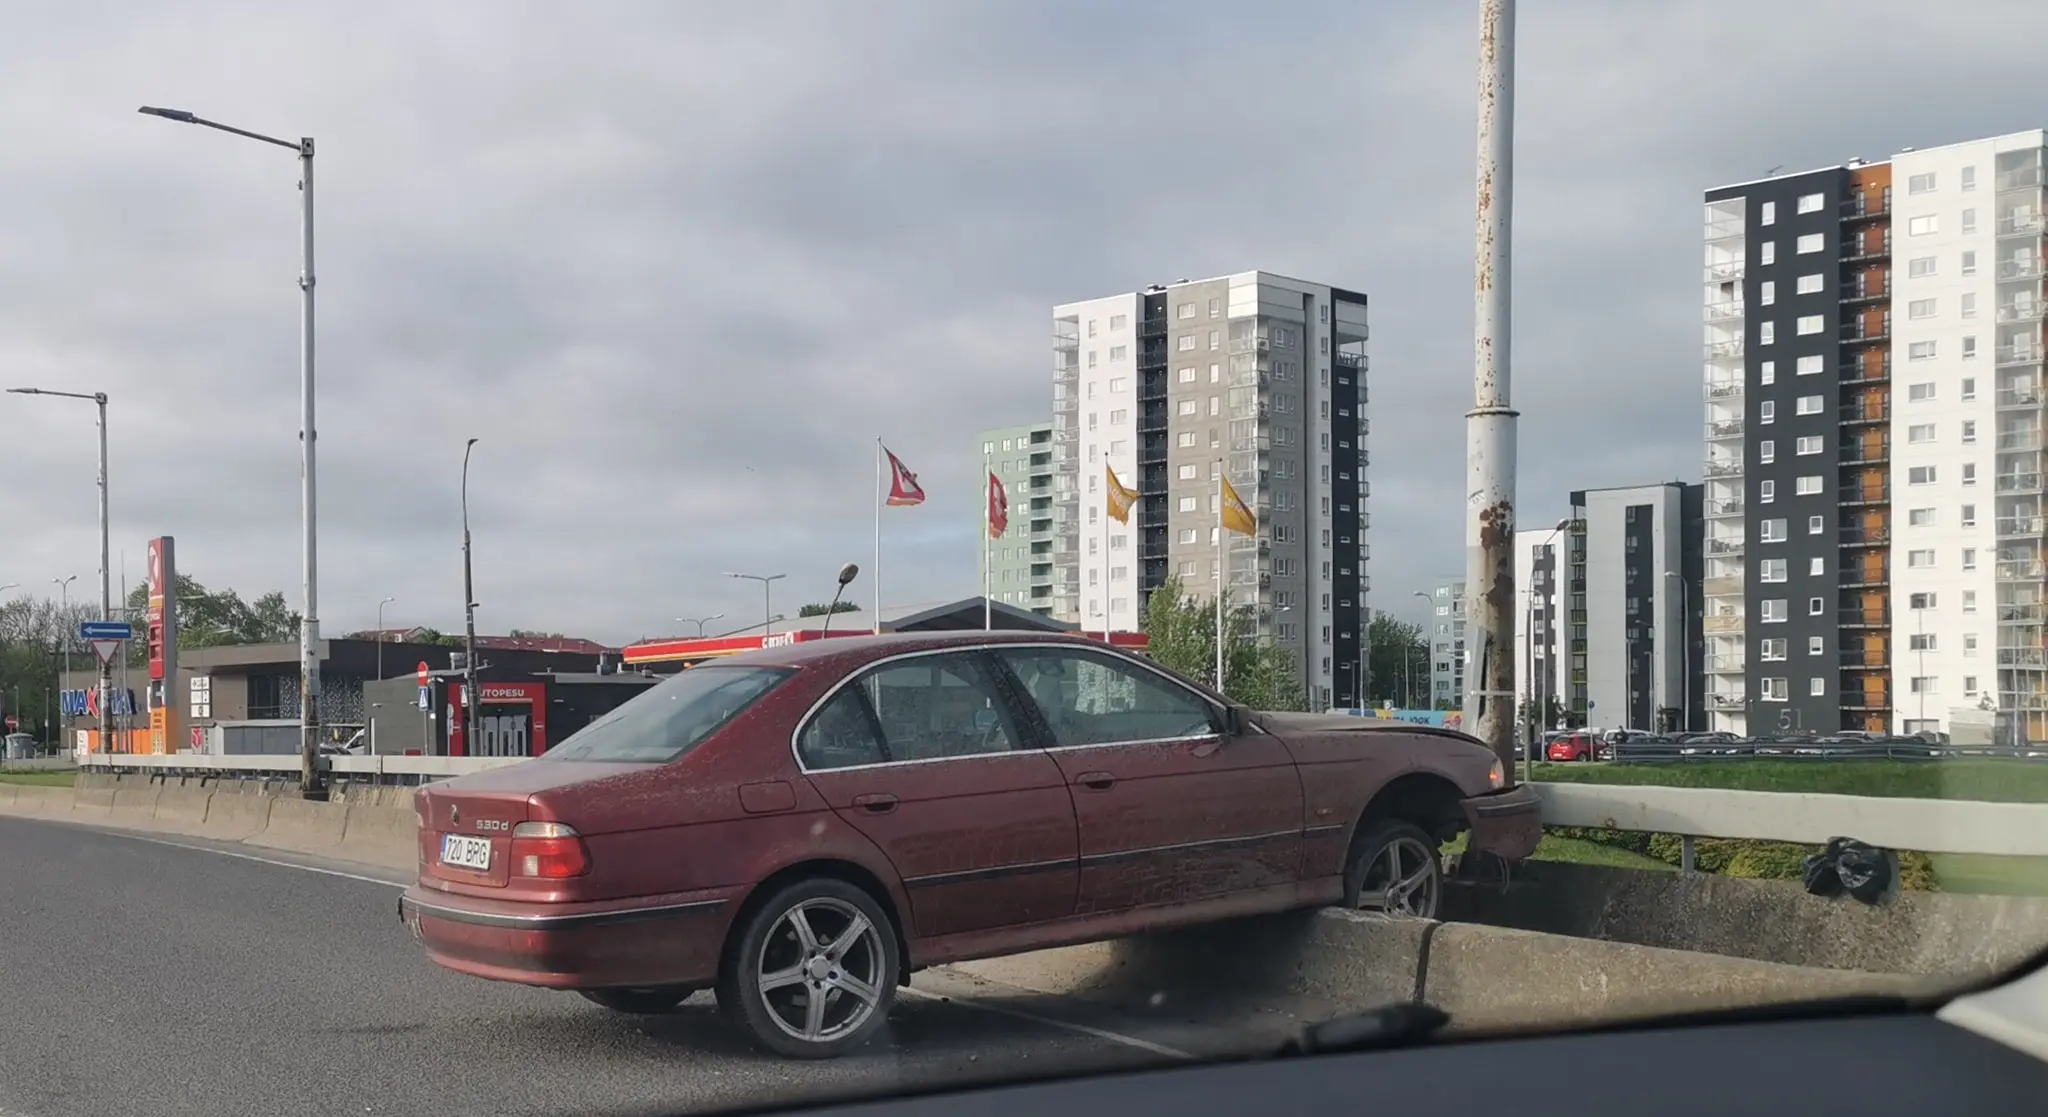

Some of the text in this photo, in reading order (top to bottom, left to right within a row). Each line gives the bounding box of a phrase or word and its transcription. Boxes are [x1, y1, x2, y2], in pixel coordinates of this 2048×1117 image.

[1777, 708, 1802, 730] 51
[476, 819, 509, 831] 530d
[445, 838, 487, 864] 720 BRG
